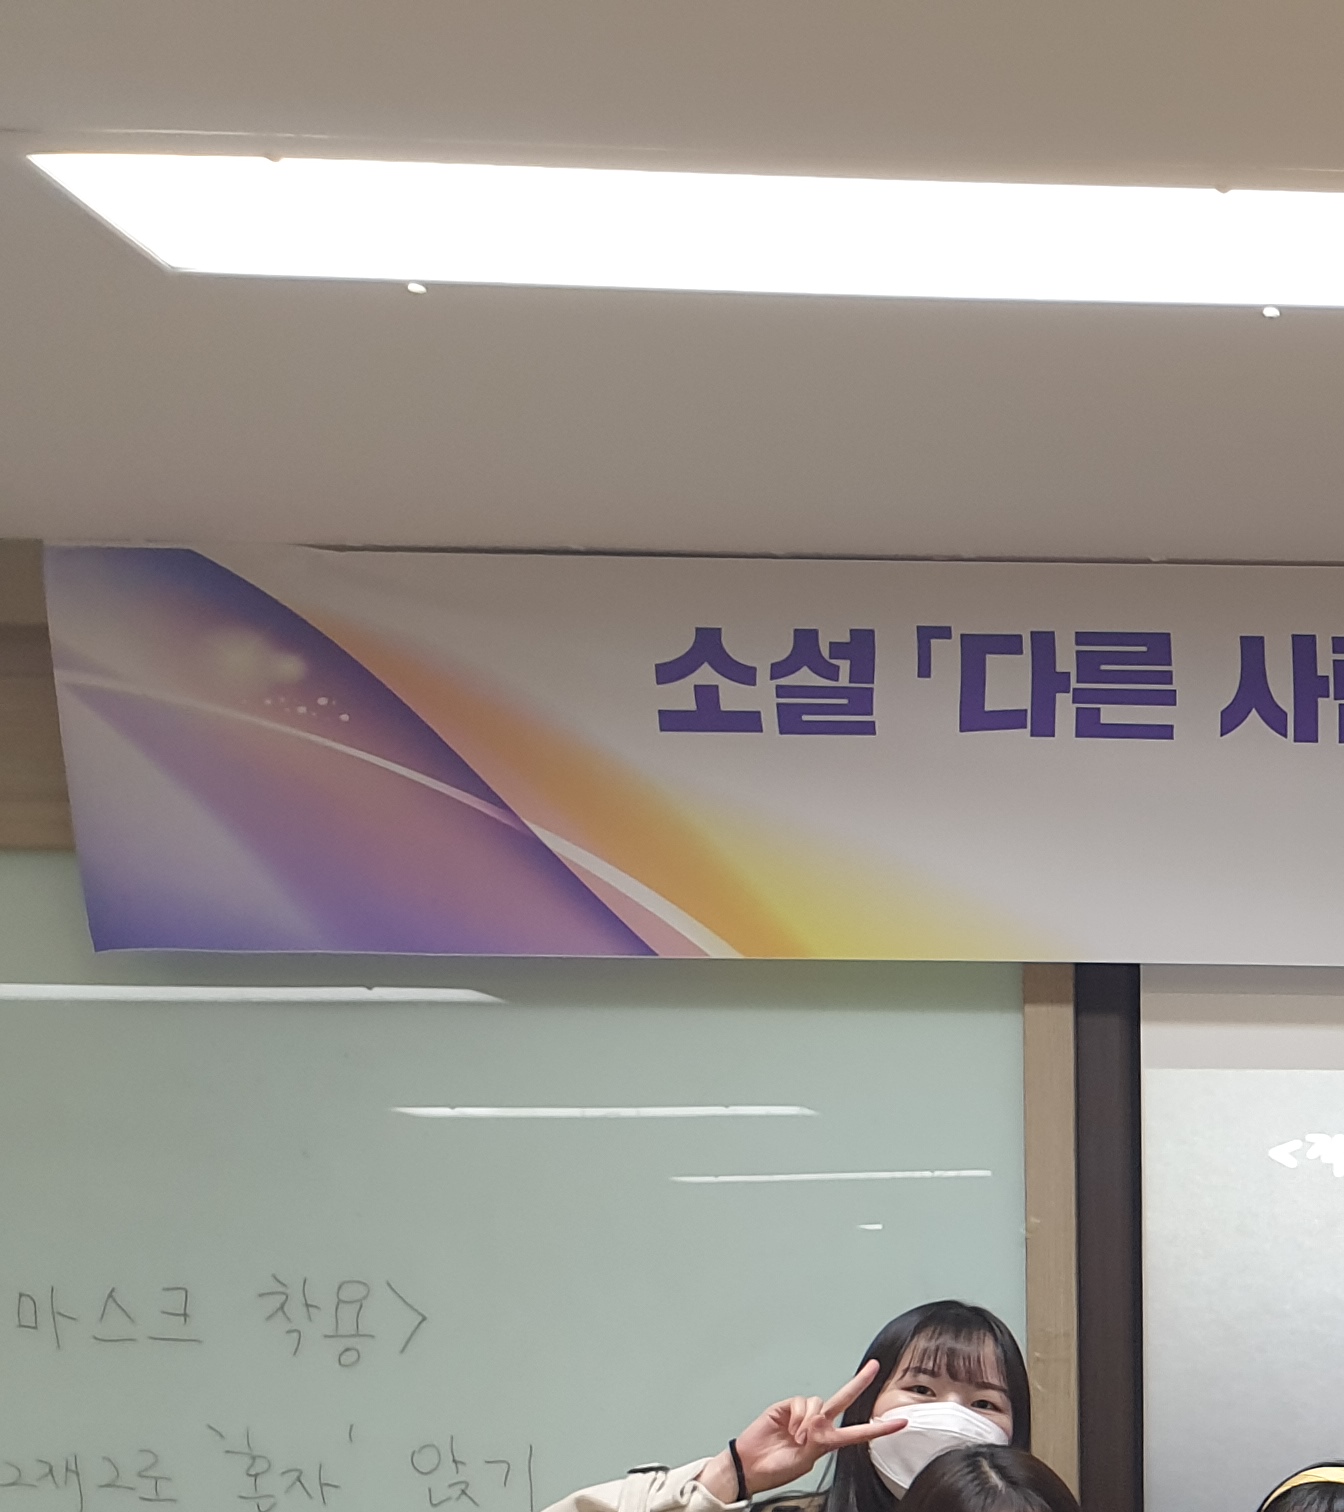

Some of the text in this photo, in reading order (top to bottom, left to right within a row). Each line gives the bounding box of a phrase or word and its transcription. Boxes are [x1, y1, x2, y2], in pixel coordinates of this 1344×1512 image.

[653, 626, 878, 737] 소설
[914, 624, 1178, 742] 「다른
[16, 1285, 204, 1351] 마스크
[410, 1434, 536, 1512] 앉기
